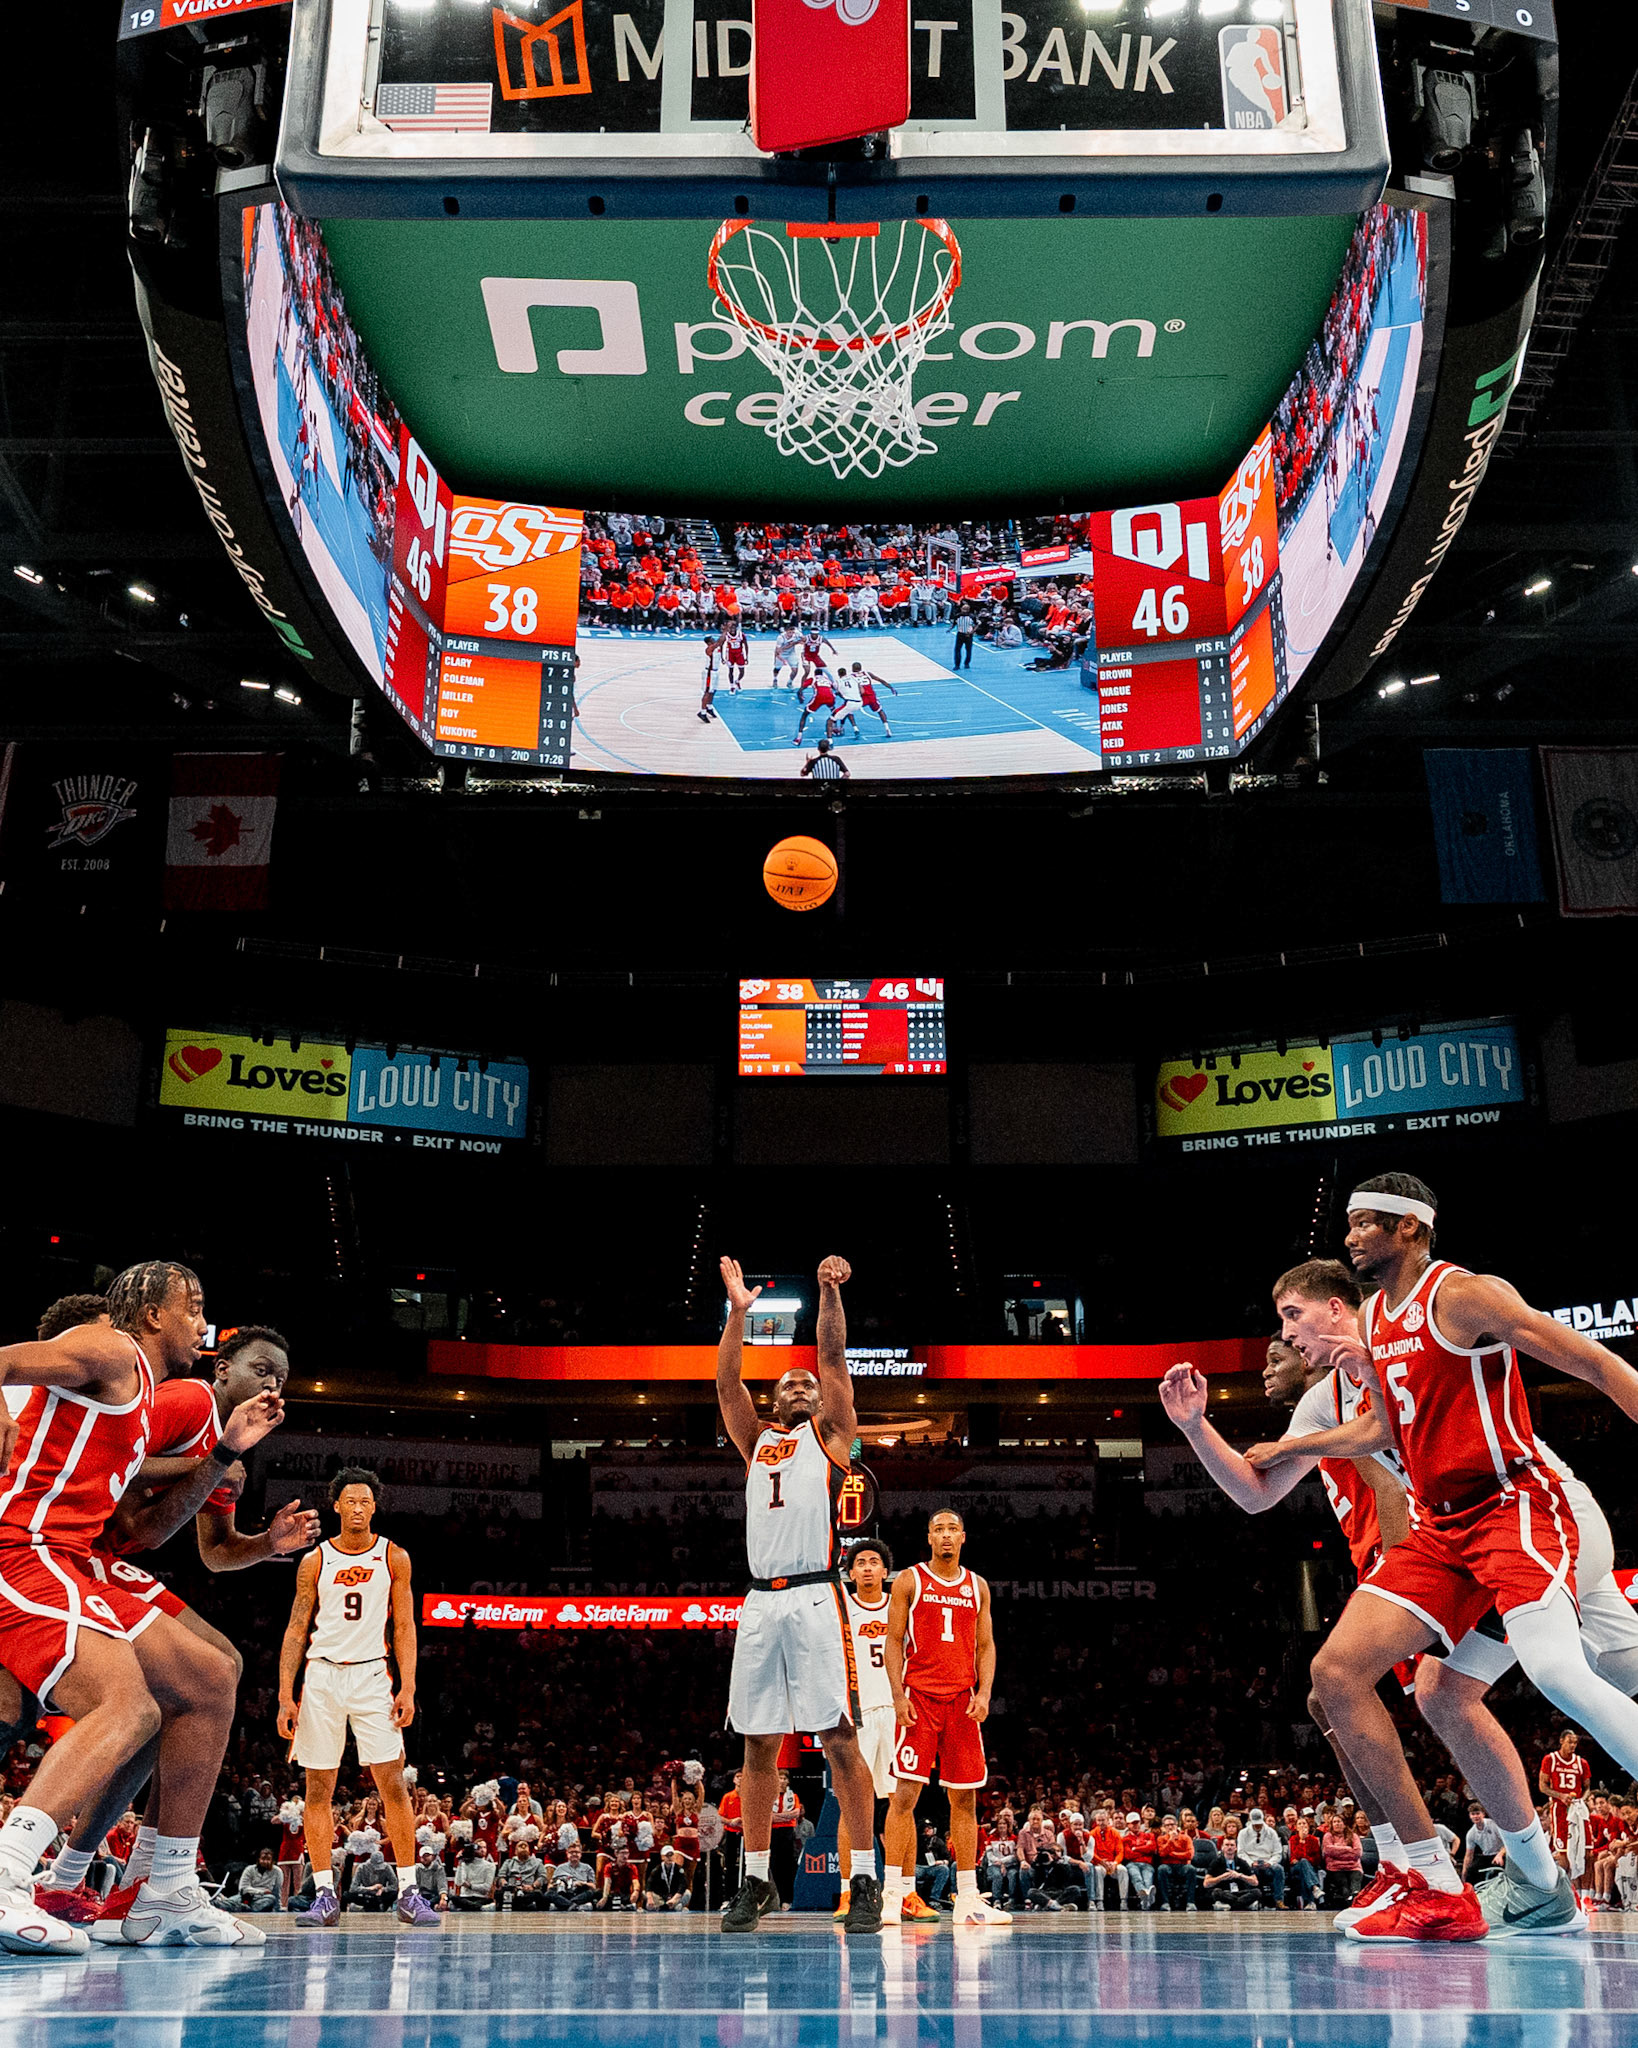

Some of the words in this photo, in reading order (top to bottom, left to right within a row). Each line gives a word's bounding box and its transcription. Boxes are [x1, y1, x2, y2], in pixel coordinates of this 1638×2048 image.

[130, 9, 155, 30] 19
[612, 13, 958, 82] MIDT
[1001, 12, 1178, 95] BANK
[1234, 110, 1265, 129] NBA
[1424, 414, 1500, 566] paycom
[193, 474, 287, 618] paycom
[406, 536, 431, 601] 46
[1240, 536, 1264, 605] 38
[483, 583, 538, 635] 38
[1132, 585, 1189, 636] 46
[446, 638, 480, 652] PLAYER
[541, 650, 559, 660] PTS
[561, 652, 572, 662] FL
[1100, 652, 1133, 663] PLAYER
[1195, 643, 1213, 653] PTS
[1215, 641, 1226, 651] FL
[444, 656, 472, 668] CLARY
[547, 667, 554, 677] 7
[562, 668, 569, 678] 2
[1099, 668, 1133, 680] BROWN
[1200, 659, 1212, 670] 10
[1218, 658, 1224, 667] 1
[443, 673, 485, 687] COLEMAN
[548, 685, 553, 694] 1
[562, 685, 568, 695] 0
[1099, 685, 1132, 697] WAGUE
[1203, 677, 1210, 687] 4
[1220, 675, 1226, 685] 1
[441, 690, 474, 703] MILLER
[546, 702, 552, 711] 7
[562, 702, 567, 712] 1
[1100, 703, 1128, 715] JONES
[1221, 692, 1226, 702] 1
[440, 707, 460, 719] ROY
[542, 719, 554, 729] 13
[560, 720, 567, 729] 0
[1101, 720, 1123, 732] ATAK
[1205, 712, 1212, 721] 3
[1222, 710, 1228, 719] 1
[439, 725, 478, 739] VUKOVIC
[543, 736, 550, 746] 4
[559, 738, 566, 747] 0
[1102, 738, 1125, 749] REID
[1207, 729, 1214, 739] 5
[1222, 727, 1229, 737] 0
[444, 744, 456, 754] TO
[460, 745, 467, 755] 3
[474, 747, 485, 757] TF
[488, 748, 495, 758] 0
[511, 750, 530, 762] 2ND
[538, 754, 564, 765] 17:26
[1110, 755, 1122, 766] TO
[1126, 754, 1133, 764] 3
[1139, 754, 1150, 763] TF
[1154, 753, 1161, 762] 2
[1176, 749, 1195, 760] 2ND
[52, 775, 138, 806] THUNDER
[1500, 791, 1515, 857] OKLAHOMA
[61, 859, 80, 870] EST.
[84, 859, 110, 871] 2008
[776, 983, 805, 1000] 38
[824, 989, 860, 1000] 17:26
[878, 982, 909, 1000] 46
[935, 1064, 941, 1072] 2
[1343, 1044, 1428, 1109] LOUD
[1438, 1042, 1512, 1091] CITY
[358, 1065, 440, 1113] LOUD
[453, 1070, 521, 1126] CITY
[184, 1114, 244, 1130] BRING
[251, 1119, 288, 1134] THE
[295, 1123, 383, 1144] THUNDER
[412, 1135, 454, 1150] EXIT
[459, 1139, 502, 1154] NOW
[1182, 1136, 1239, 1152] BRING
[1244, 1132, 1281, 1145] THE
[1286, 1123, 1376, 1142] THUNDER
[1406, 1115, 1450, 1131] EXIT
[1455, 1110, 1500, 1125] NOW
[1581, 1324, 1634, 1340] KETBALL
[894, 1349, 908, 1358] BY
[1372, 1336, 1425, 1361] OKLAHOMA
[1386, 1362, 1416, 1425] 5
[768, 1471, 785, 1509] 1
[344, 1592, 363, 1621] 9
[922, 1593, 974, 1609] OKLAHOMA
[583, 1604, 670, 1623] StateFarm
[708, 1604, 743, 1622] Stat
[940, 1607, 955, 1642] 1
[869, 1644, 884, 1668] 5
[900, 1746, 919, 1771] OU
[1558, 1773, 1576, 1790] 13
[9, 1817, 36, 1832] 23
